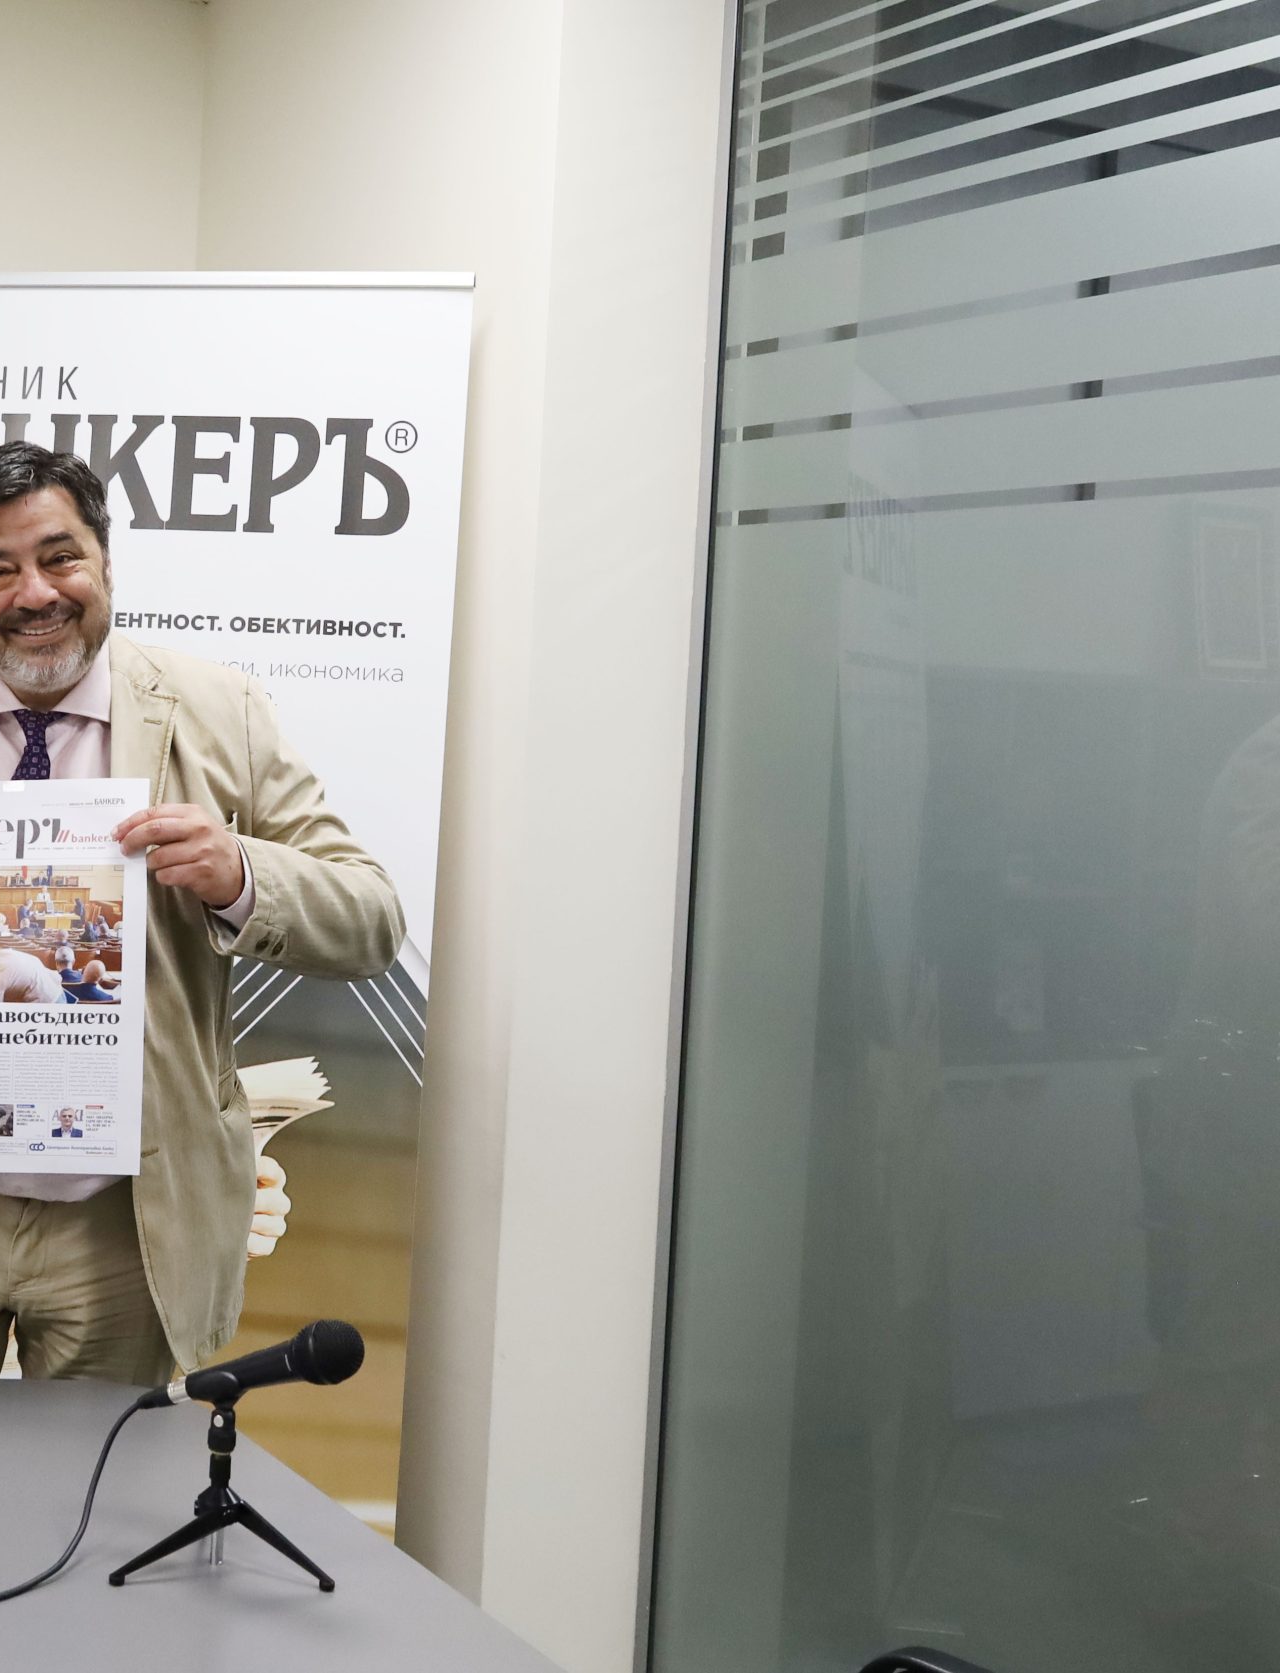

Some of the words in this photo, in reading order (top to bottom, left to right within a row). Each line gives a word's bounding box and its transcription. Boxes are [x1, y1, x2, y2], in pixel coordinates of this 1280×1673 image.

[113, 612, 223, 632] ЕНТНОСТ.
[229, 616, 407, 639] ОБЕКТИВНОСТ.
[269, 663, 405, 683] икономика
